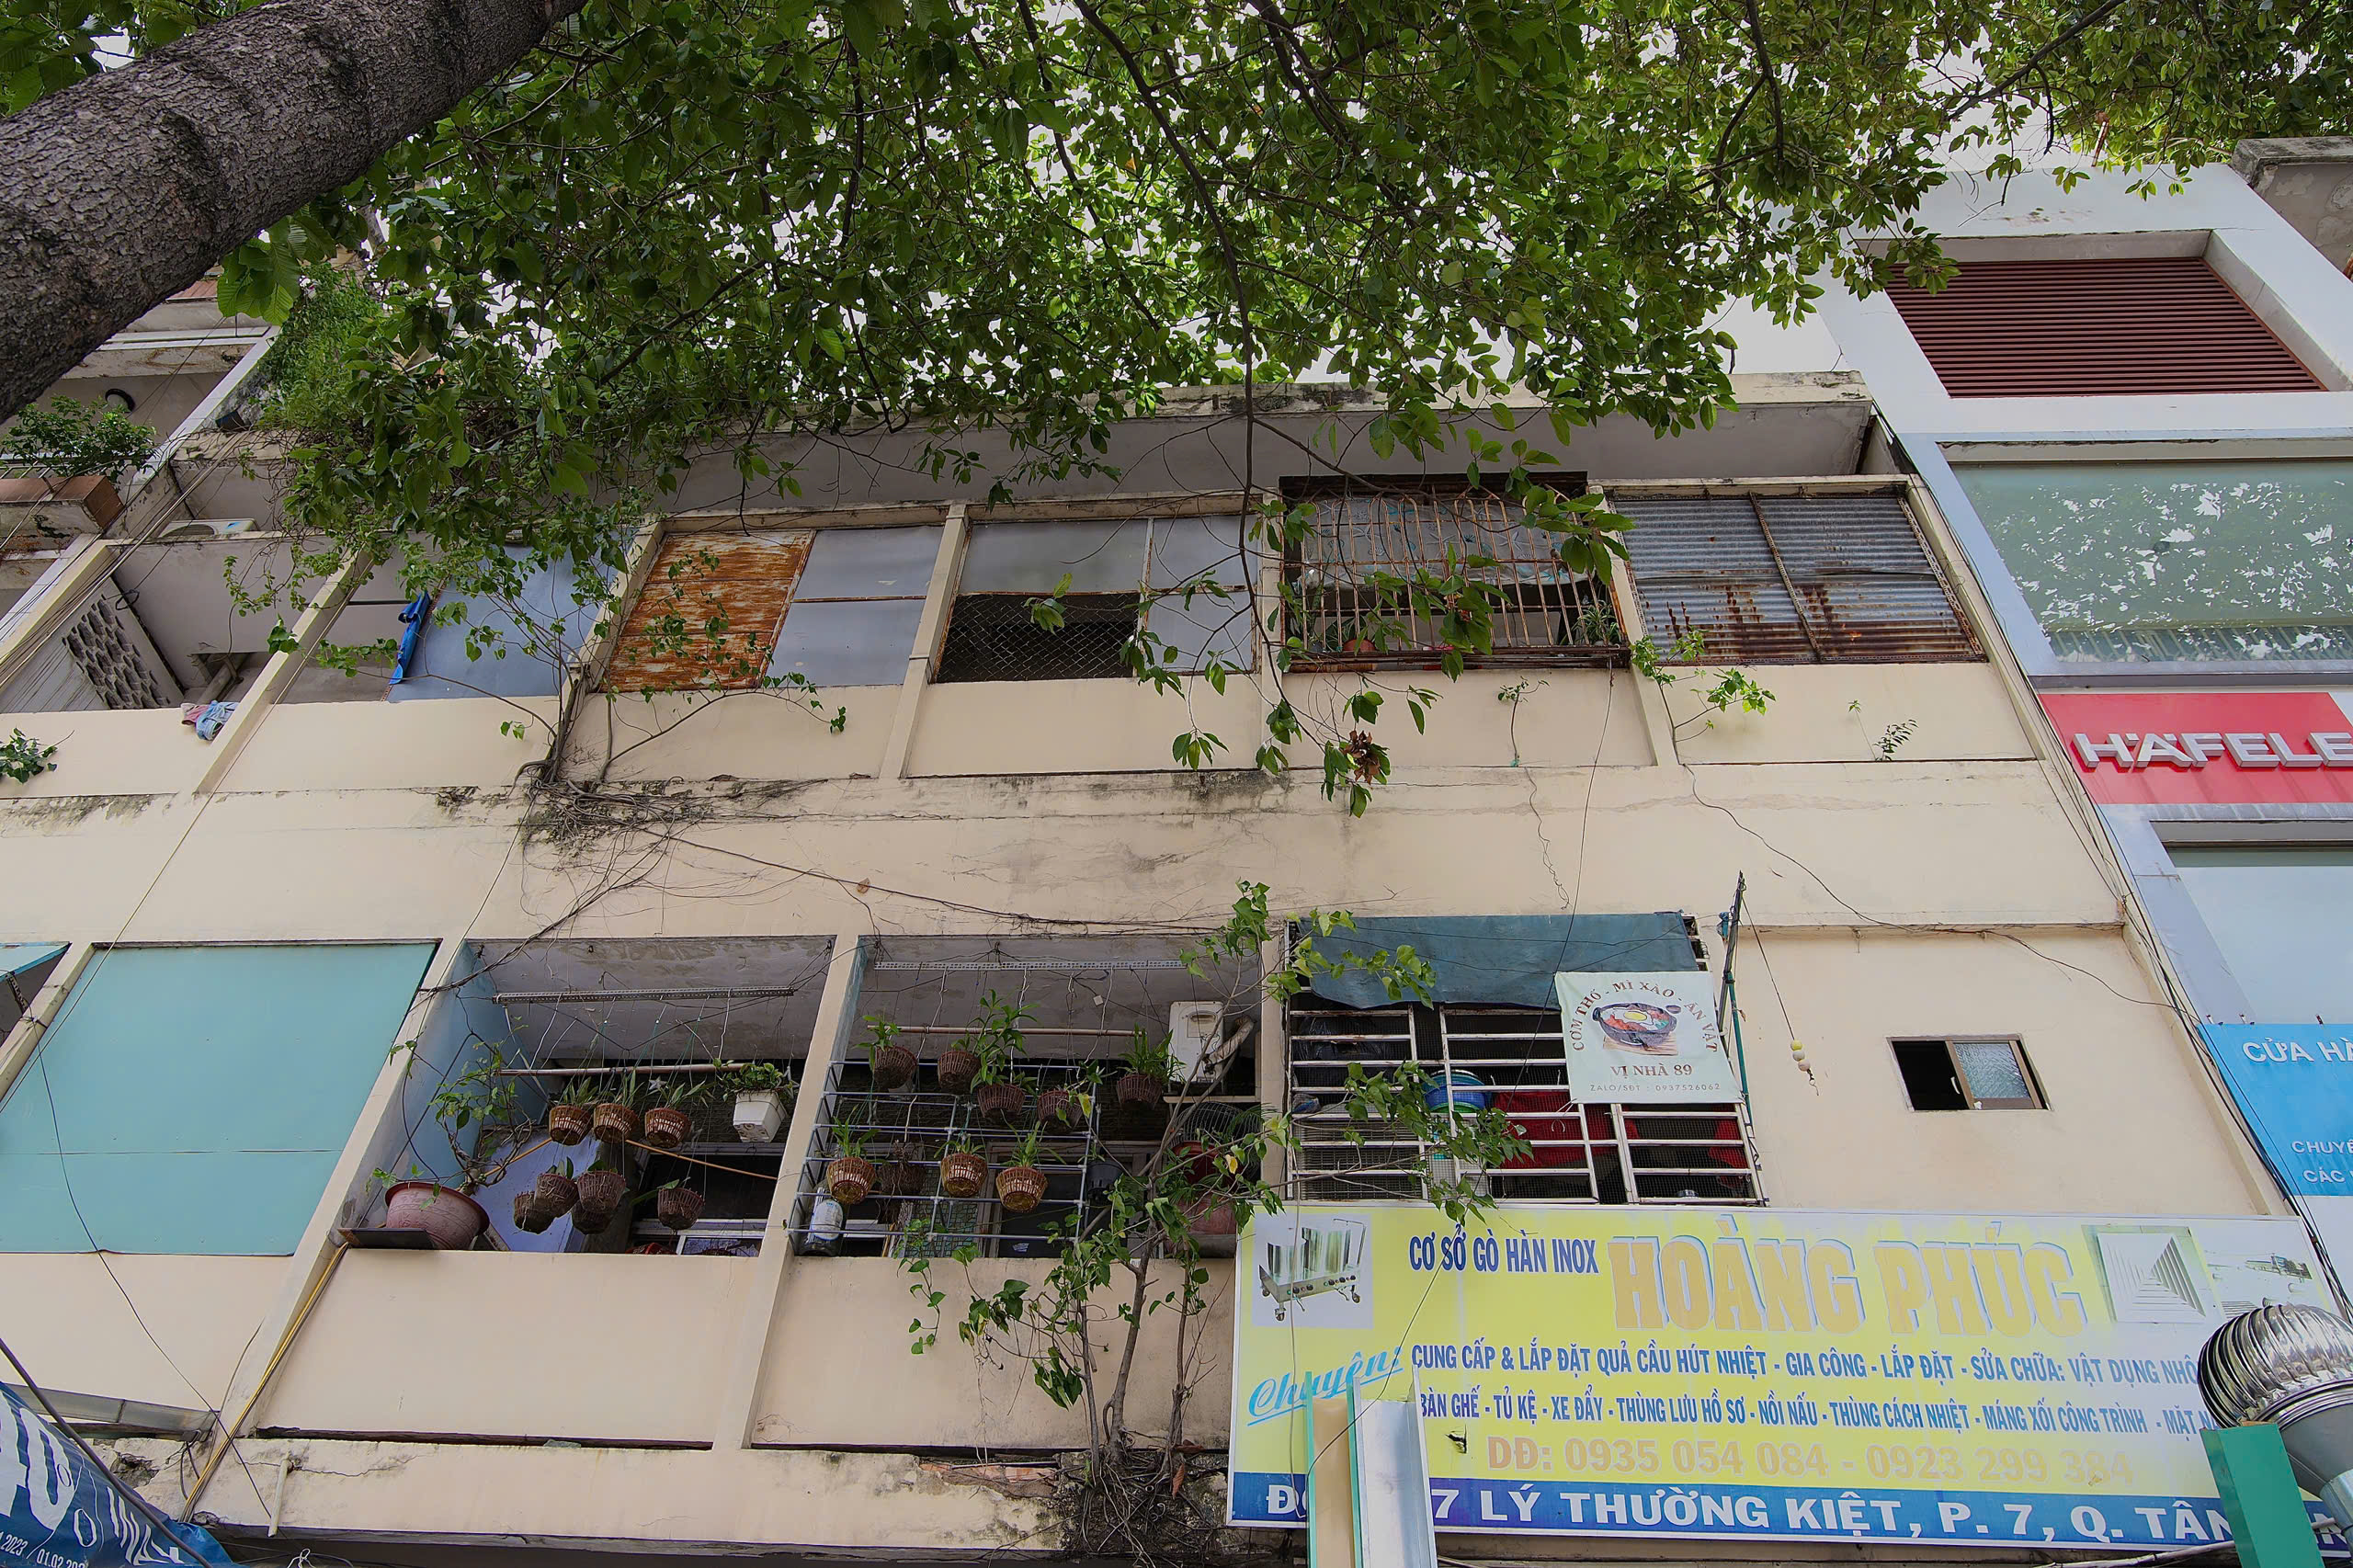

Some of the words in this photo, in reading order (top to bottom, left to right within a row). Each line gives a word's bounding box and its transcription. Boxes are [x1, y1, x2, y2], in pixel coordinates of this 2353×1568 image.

[1571, 1018, 1585, 1051] CƠM
[1612, 980, 1633, 993] MÌ
[1640, 981, 1675, 998] XÀO
[1610, 1065, 1629, 1079] VỊ
[1632, 1062, 1669, 1076] NHÀ
[1674, 1063, 1693, 1076] 89
[2242, 1037, 2315, 1062] CỬA
[1409, 1232, 1436, 1271] CƠ
[1440, 1223, 1467, 1271] SỞ
[1473, 1229, 1499, 1272] GÒ
[1506, 1230, 1548, 1273] HÀN
[1552, 1238, 1599, 1274] INOX
[1607, 1214, 1867, 1334] HOÀNG
[1872, 1221, 2089, 1337] PHÚC
[1412, 1345, 1457, 1369] CUNG
[1461, 1337, 1496, 1370] CẤP
[1501, 1346, 1515, 1370] &
[1519, 1337, 1553, 1371] LẮP
[1557, 1344, 1591, 1379] ĐẶT
[1597, 1340, 1632, 1377] QUẢ
[1636, 1339, 1671, 1373] CẦU
[1677, 1344, 1711, 1374] HÚT
[1716, 1345, 1767, 1380] NHIỆT
[1786, 1352, 1815, 1377] GIA
[1818, 1347, 1867, 1378] CÔNG
[1881, 1345, 1915, 1378] LẮP
[1919, 1350, 1954, 1386] ĐẶT
[1971, 1347, 2008, 1381] SỬA
[2010, 1352, 2066, 1381] CHỮA:
[2067, 1352, 2104, 1388] VẬT
[2108, 1359, 2160, 1389] DỤNG
[2160, 1355, 2200, 1384] NHÔ
[1450, 1385, 1480, 1418] GHẾ
[1494, 1386, 1512, 1419] TỦ
[1518, 1390, 1538, 1425] KỆ
[1552, 1396, 1571, 1420] XE
[1574, 1384, 1603, 1421] ĐẨY
[1616, 1392, 1666, 1424] THÙNG
[1668, 1394, 1698, 1424] LƯU
[1701, 1388, 1722, 1424] HỒ
[1726, 1396, 1745, 1424] SƠ
[1757, 1390, 1785, 1425] NỒI
[1787, 1392, 1818, 1426] NẤU
[1829, 1396, 1881, 1427] THÙNG
[1882, 1397, 1925, 1427] CÁCH
[1925, 1398, 1971, 1434] NHIỆT
[1982, 1399, 2029, 1431] MÁNG
[2028, 1397, 2057, 1432] XỐI
[2057, 1401, 2098, 1433] CÔNG
[2099, 1402, 2149, 1434] TRÌNH
[2162, 1404, 2198, 1442] MẶT
[1487, 1436, 1552, 1471] DĐ:
[1564, 1437, 1660, 1472] 0935
[1672, 1440, 1743, 1475] 054
[1756, 1442, 1829, 1478] 084
[1866, 1444, 1964, 1480] 0923
[1975, 1447, 2048, 1483] 299
[1480, 1483, 1541, 1522] LÝ
[1560, 1486, 1770, 1528] THƯỜNG
[1785, 1491, 1922, 1538] KIỆT,
[1937, 1502, 1990, 1534] P.
[2004, 1503, 2055, 1542] 7,
[2070, 1506, 2124, 1544] Q.
